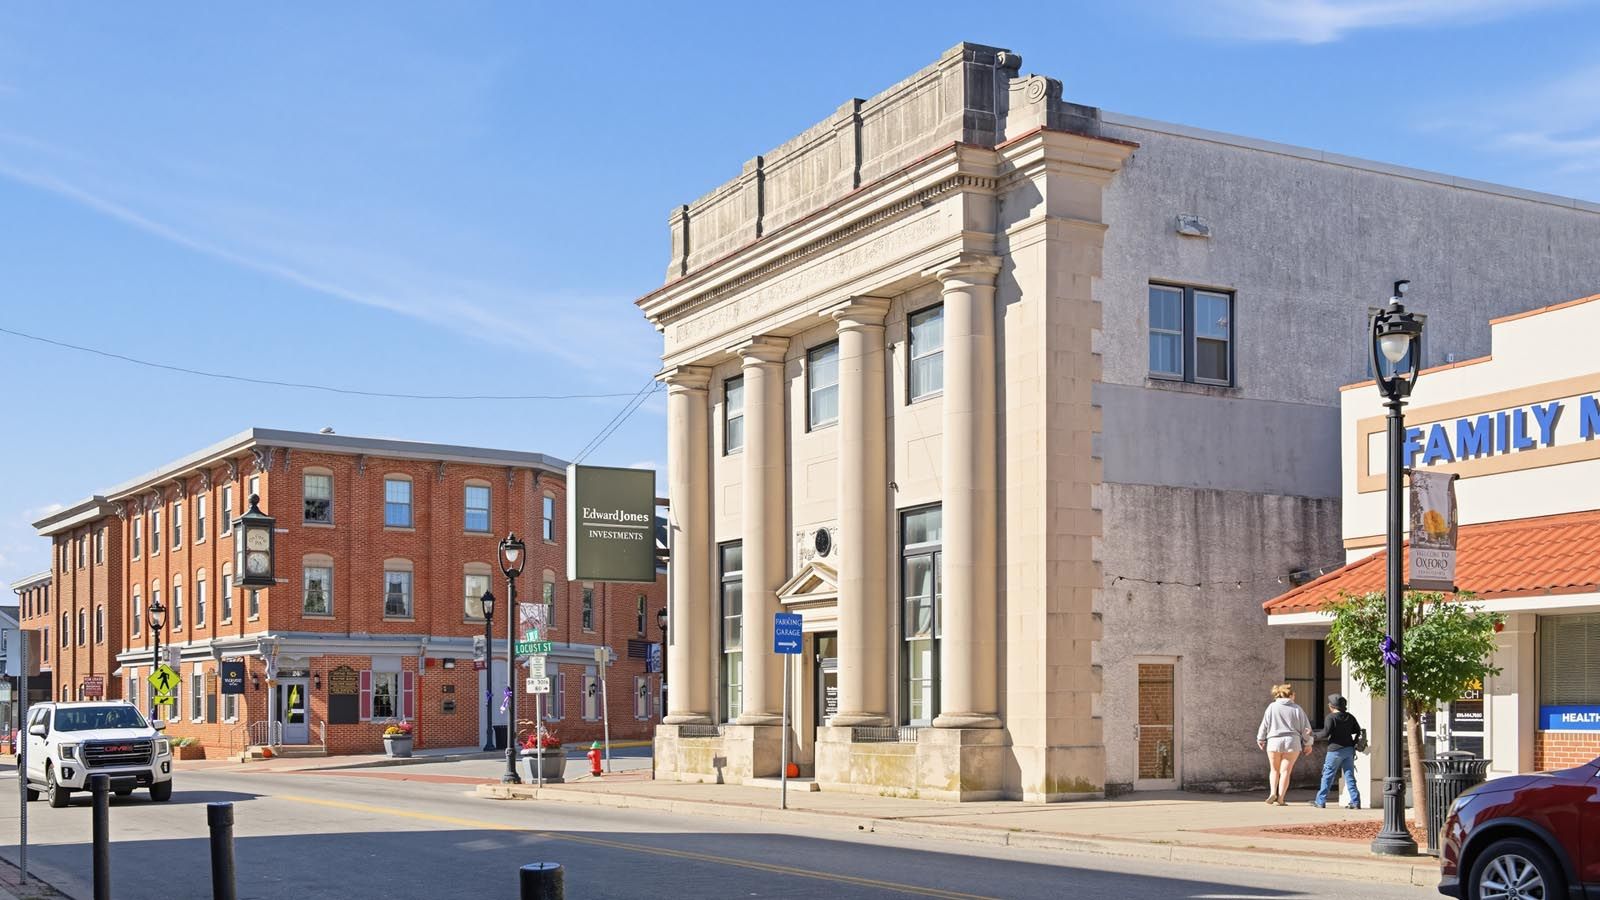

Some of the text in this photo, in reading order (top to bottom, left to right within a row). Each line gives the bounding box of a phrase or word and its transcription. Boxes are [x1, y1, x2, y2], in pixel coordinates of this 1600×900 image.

[1403, 402, 1561, 466] FAMILY
[589, 530, 644, 541] INVESTMENTS
[1416, 557, 1448, 570] OXFORD
[775, 618, 802, 627] PARKING
[775, 629, 801, 637] GARAGE
[515, 642, 552, 654] LOCUST ST
[1562, 712, 1600, 723] HEALTH
[104, 744, 134, 753] GMC
